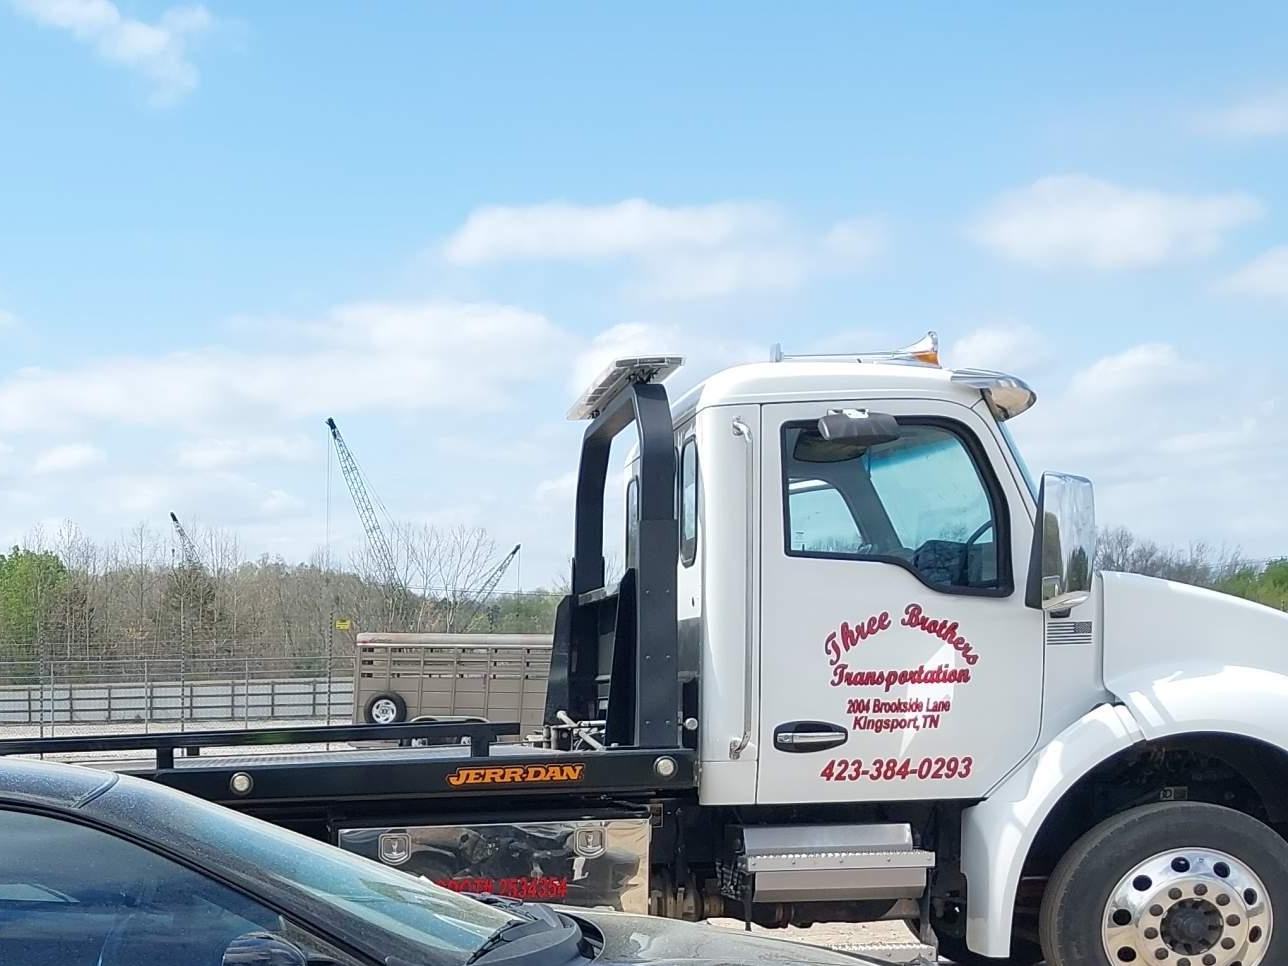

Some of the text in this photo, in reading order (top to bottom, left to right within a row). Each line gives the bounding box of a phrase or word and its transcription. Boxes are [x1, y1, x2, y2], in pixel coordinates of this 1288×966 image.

[824, 603, 980, 666] Three Brothers
[830, 664, 971, 692] Transportation
[847, 698, 951, 713] 2004 Brookside Lane
[922, 715, 940, 728] TN
[820, 757, 973, 781] 423-384-0293
